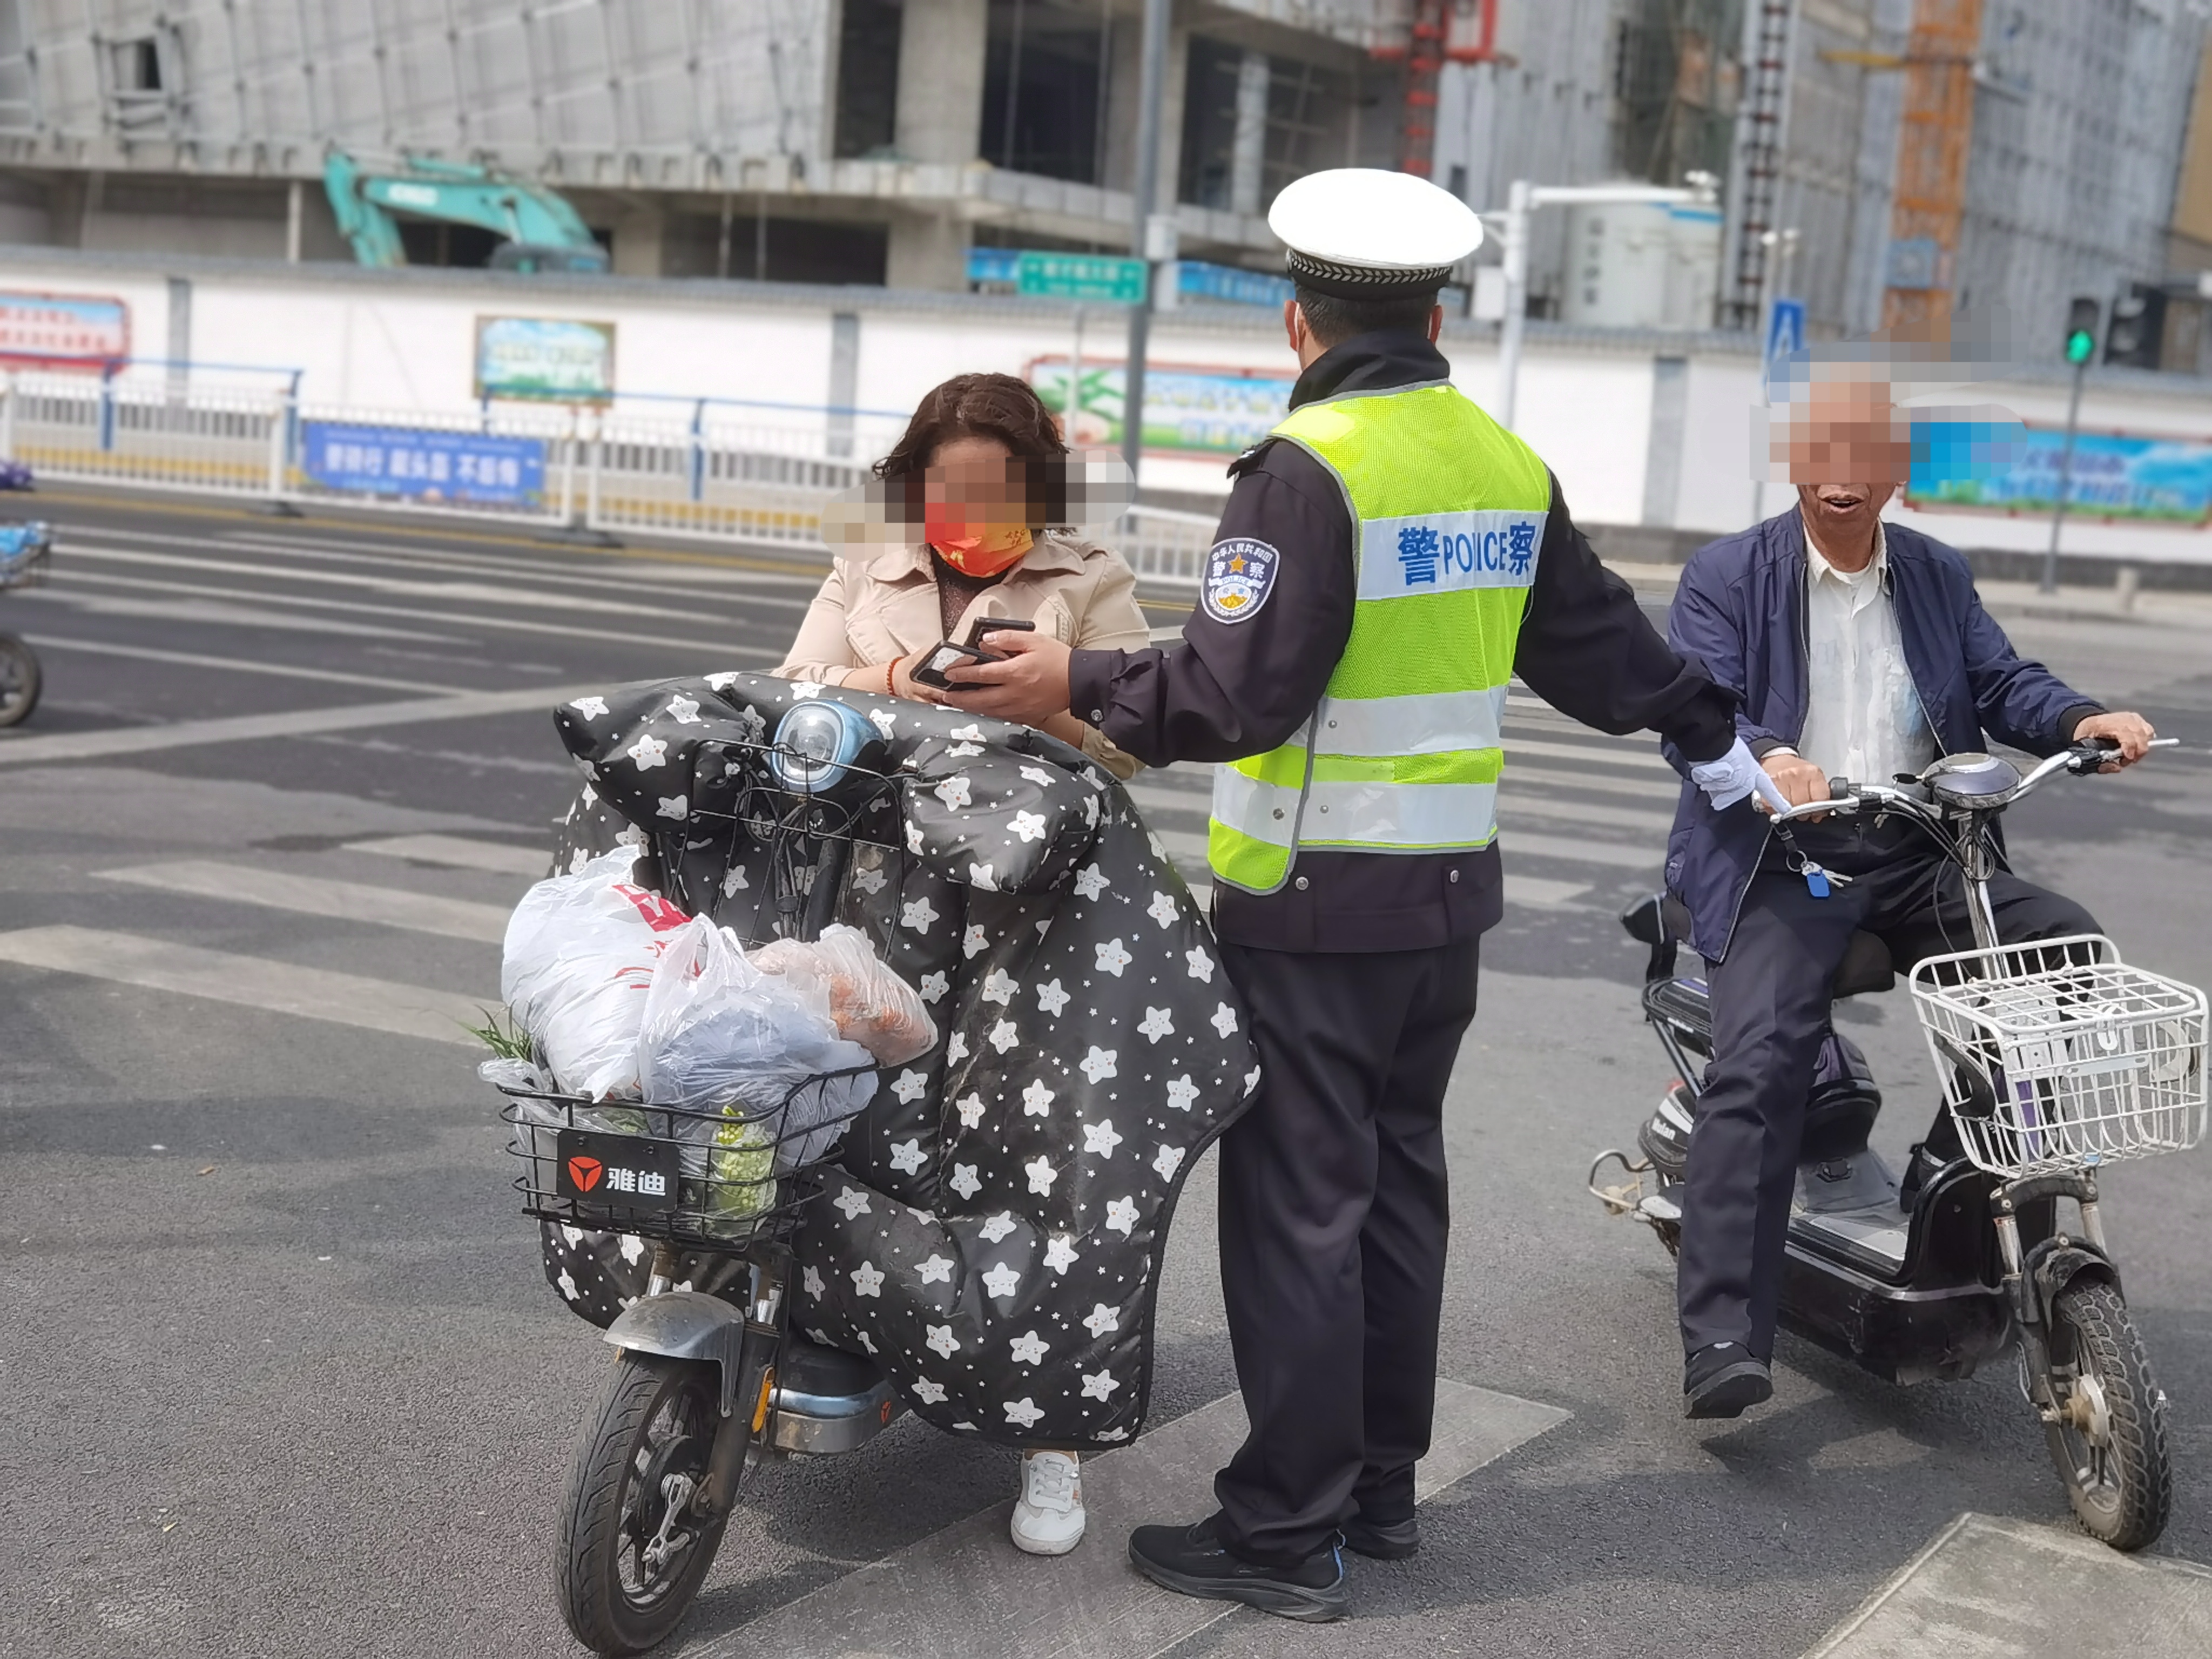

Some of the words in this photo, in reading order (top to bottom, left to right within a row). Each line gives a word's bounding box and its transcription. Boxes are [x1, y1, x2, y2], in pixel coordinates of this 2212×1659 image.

[1212, 543, 1273, 563] 中华人民共和国
[606, 1168, 666, 1196] 雅迪
